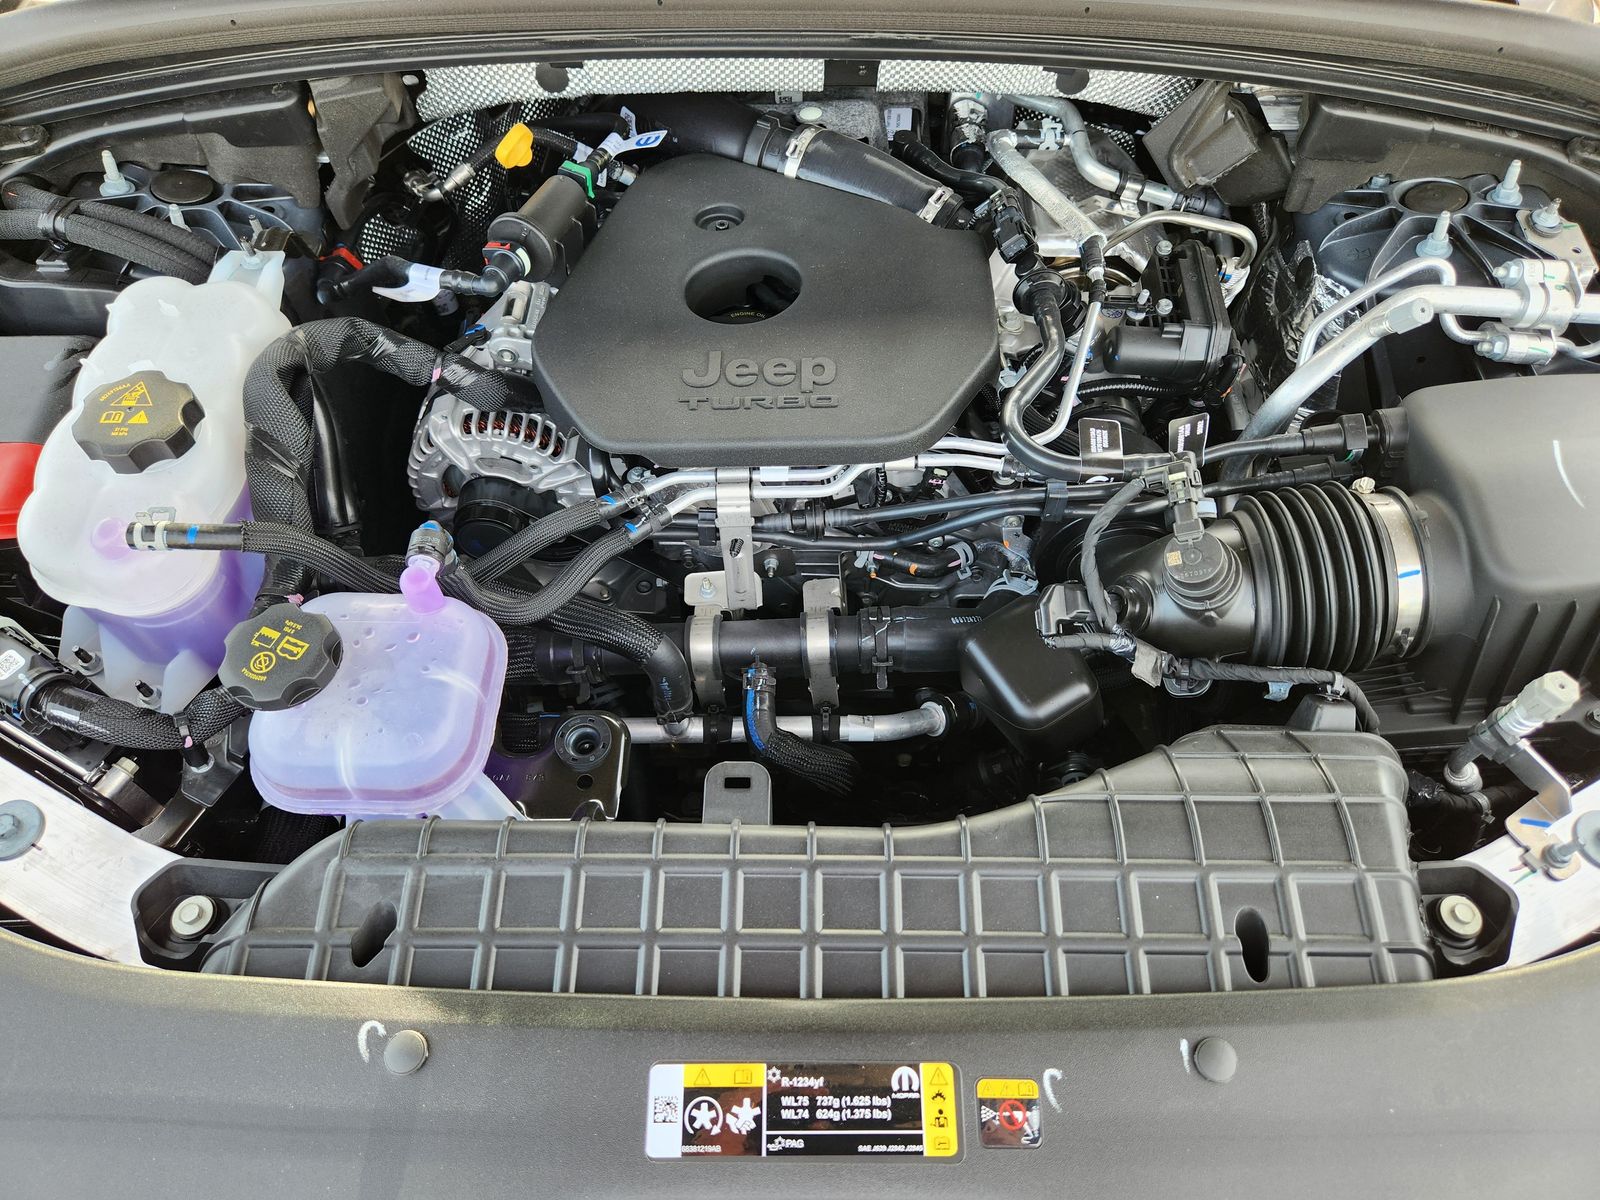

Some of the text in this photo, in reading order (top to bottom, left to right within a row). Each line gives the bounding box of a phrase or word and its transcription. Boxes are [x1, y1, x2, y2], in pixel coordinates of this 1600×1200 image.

[681, 350, 837, 394] Jeep
[678, 394, 839, 411] TURBO
[781, 1076, 824, 1089] R-1234yf
[781, 1096, 892, 1108] WL75 737g (1.625 lbs)
[781, 1109, 892, 1121] WL74 624g (1.375 lbs)
[785, 1139, 804, 1149] PAG
